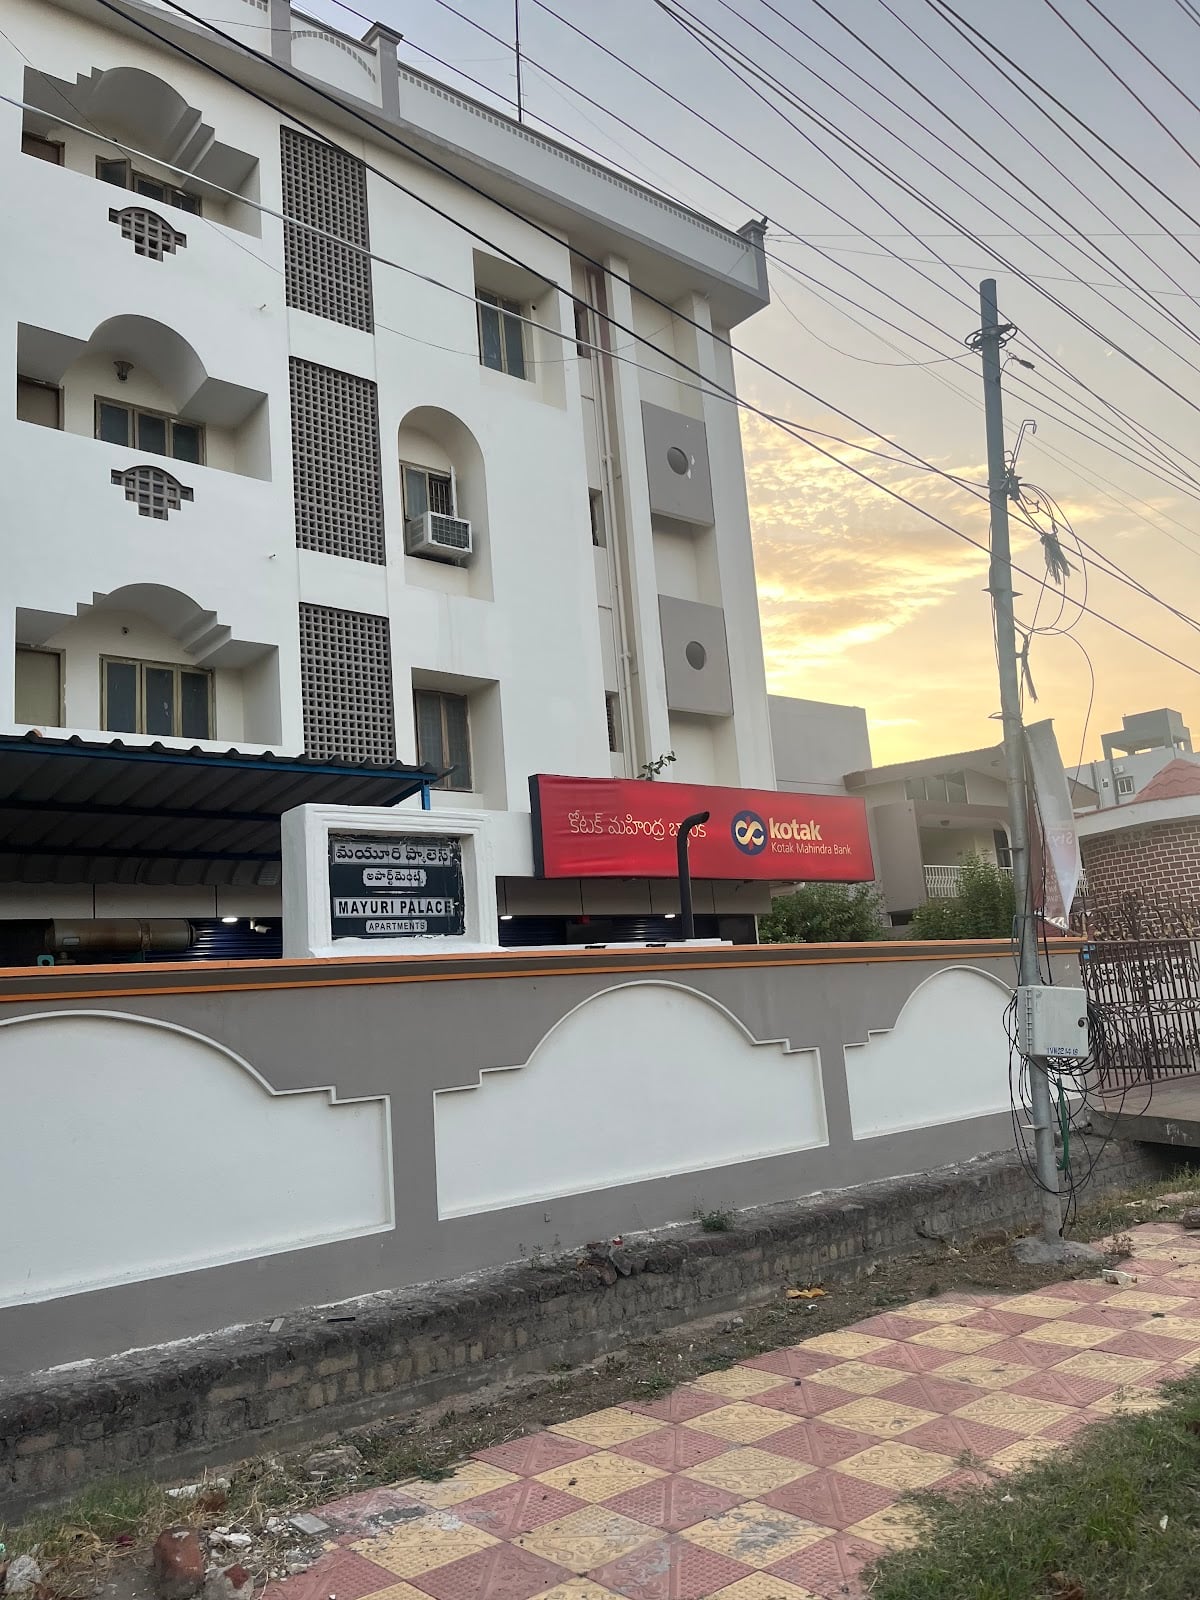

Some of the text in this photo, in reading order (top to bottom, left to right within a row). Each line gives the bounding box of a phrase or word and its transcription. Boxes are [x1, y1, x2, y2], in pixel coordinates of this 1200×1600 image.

[608, 813, 665, 841] మహింద్ర
[768, 817, 822, 840] kotak
[771, 842, 852, 855] Kotak Mahindra Bank
[338, 900, 451, 914] MAYURI PALACE
[368, 922, 425, 931] APARTMENTS
